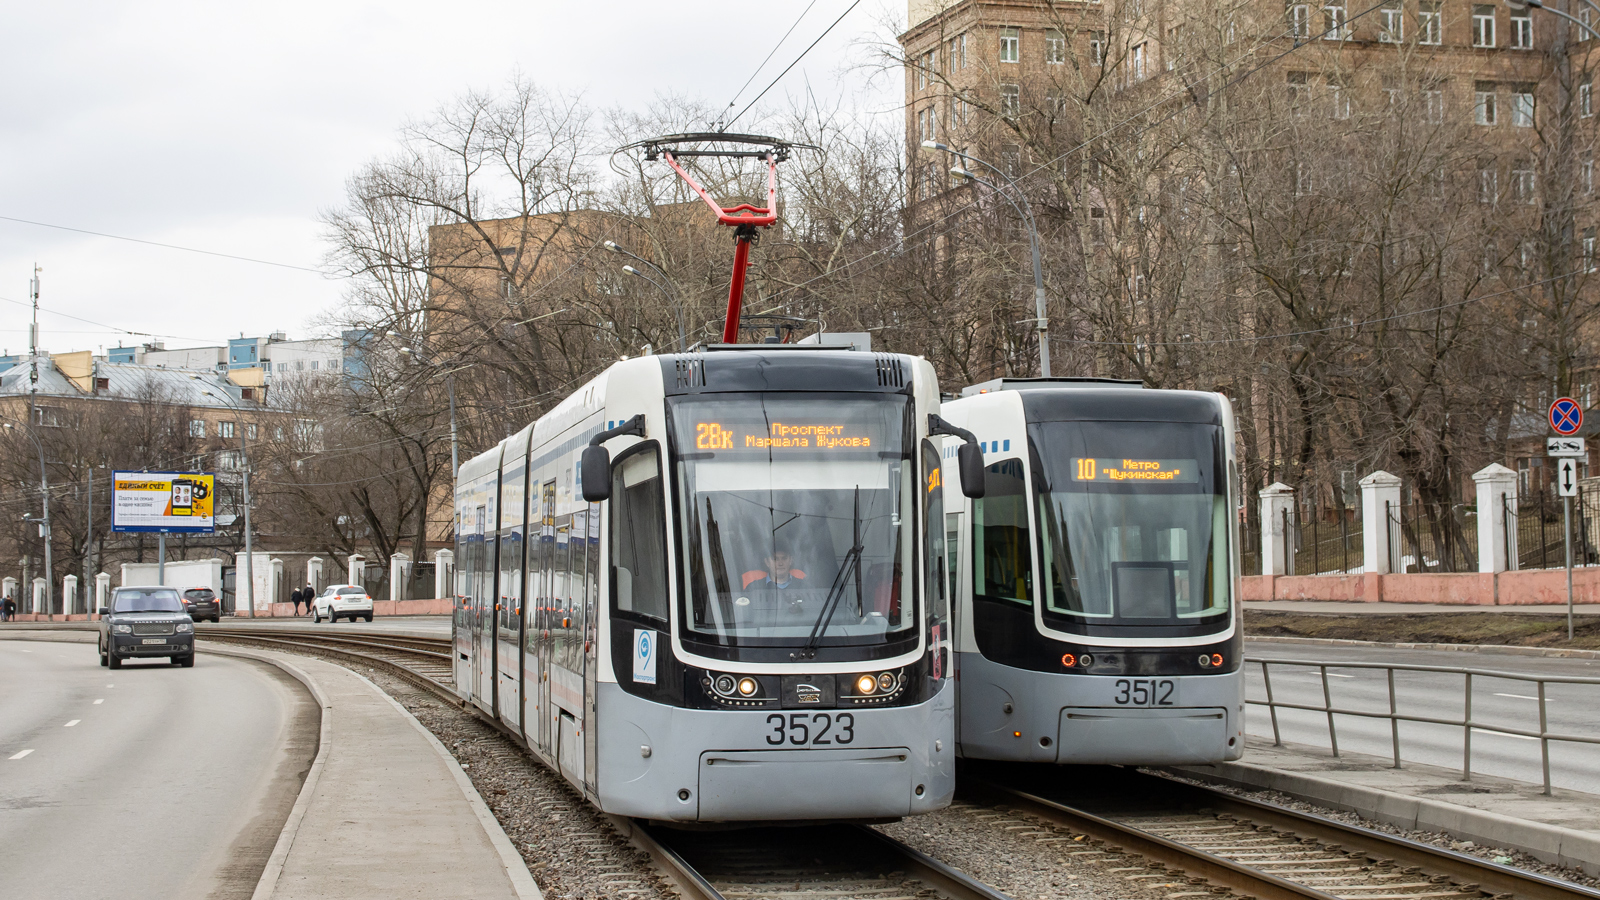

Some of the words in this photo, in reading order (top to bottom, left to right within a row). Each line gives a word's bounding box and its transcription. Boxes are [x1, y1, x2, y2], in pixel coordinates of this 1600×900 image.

[696, 423, 734, 449] 28к
[771, 422, 844, 437] Проспект
[745, 435, 809, 448] Маршала
[816, 435, 871, 449] Жукова
[1077, 458, 1096, 480] 10
[1122, 458, 1160, 470] Метро
[1102, 468, 1180, 481] "Щукинская"
[1114, 679, 1175, 706] 3512
[765, 713, 855, 745] 3523
